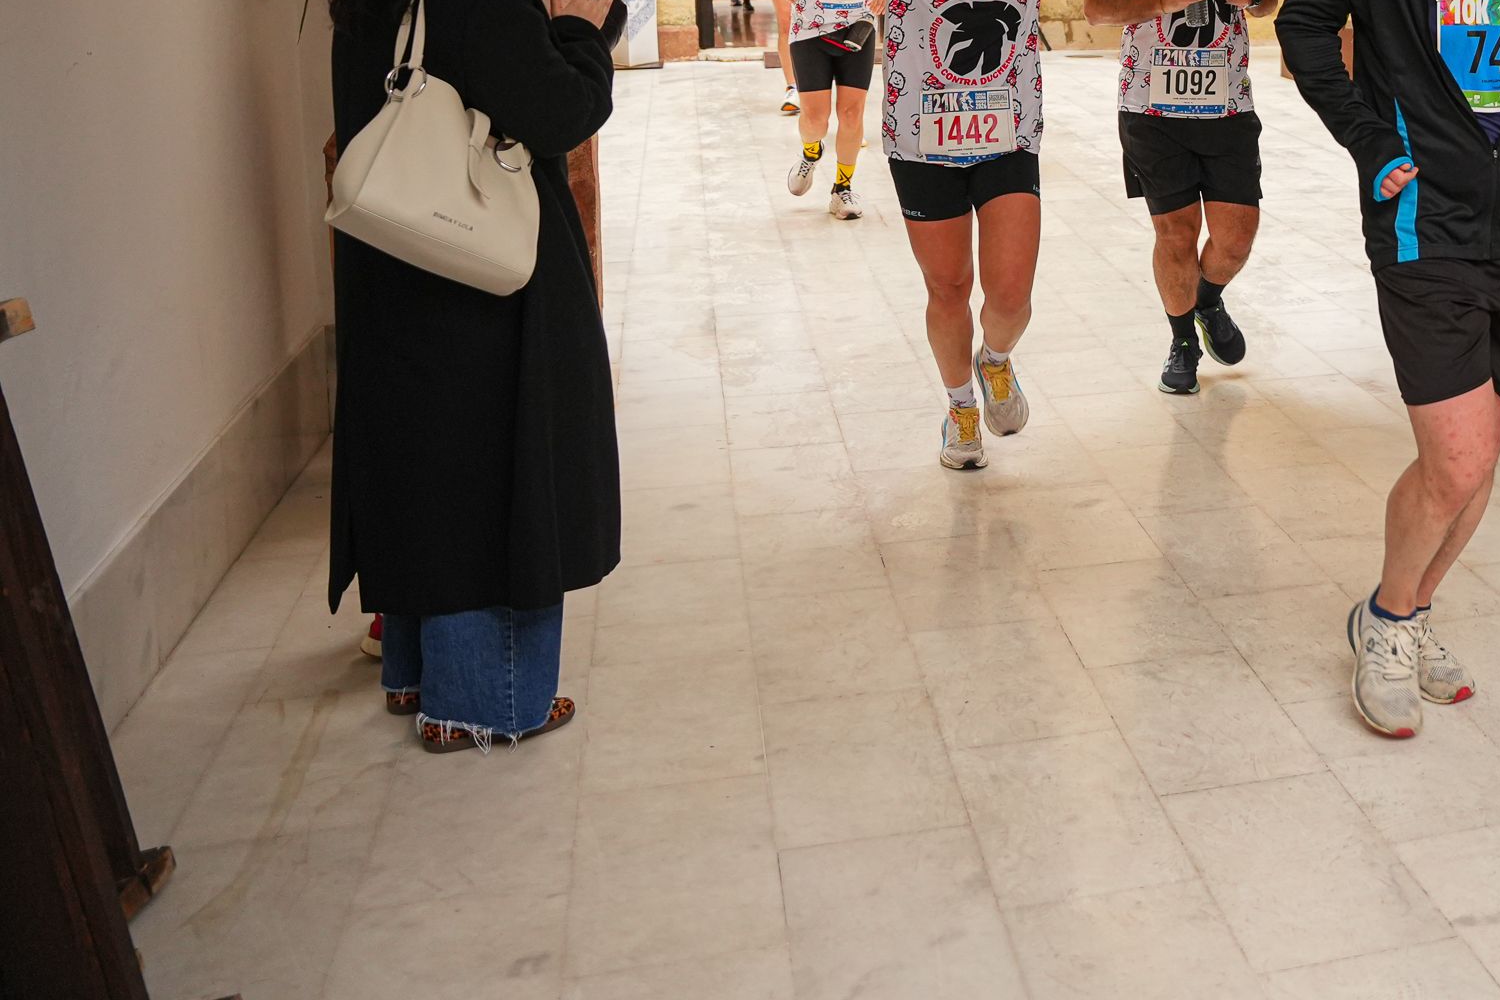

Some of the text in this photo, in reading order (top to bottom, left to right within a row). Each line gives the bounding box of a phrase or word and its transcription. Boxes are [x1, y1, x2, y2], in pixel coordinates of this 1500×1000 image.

[929, 16, 1016, 86] GUERREROS CONTRA DUCHENNE
[1163, 50, 1187, 66] 21K
[1162, 69, 1217, 95] 1092
[933, 92, 959, 112] 21K
[934, 113, 999, 146] 1442
